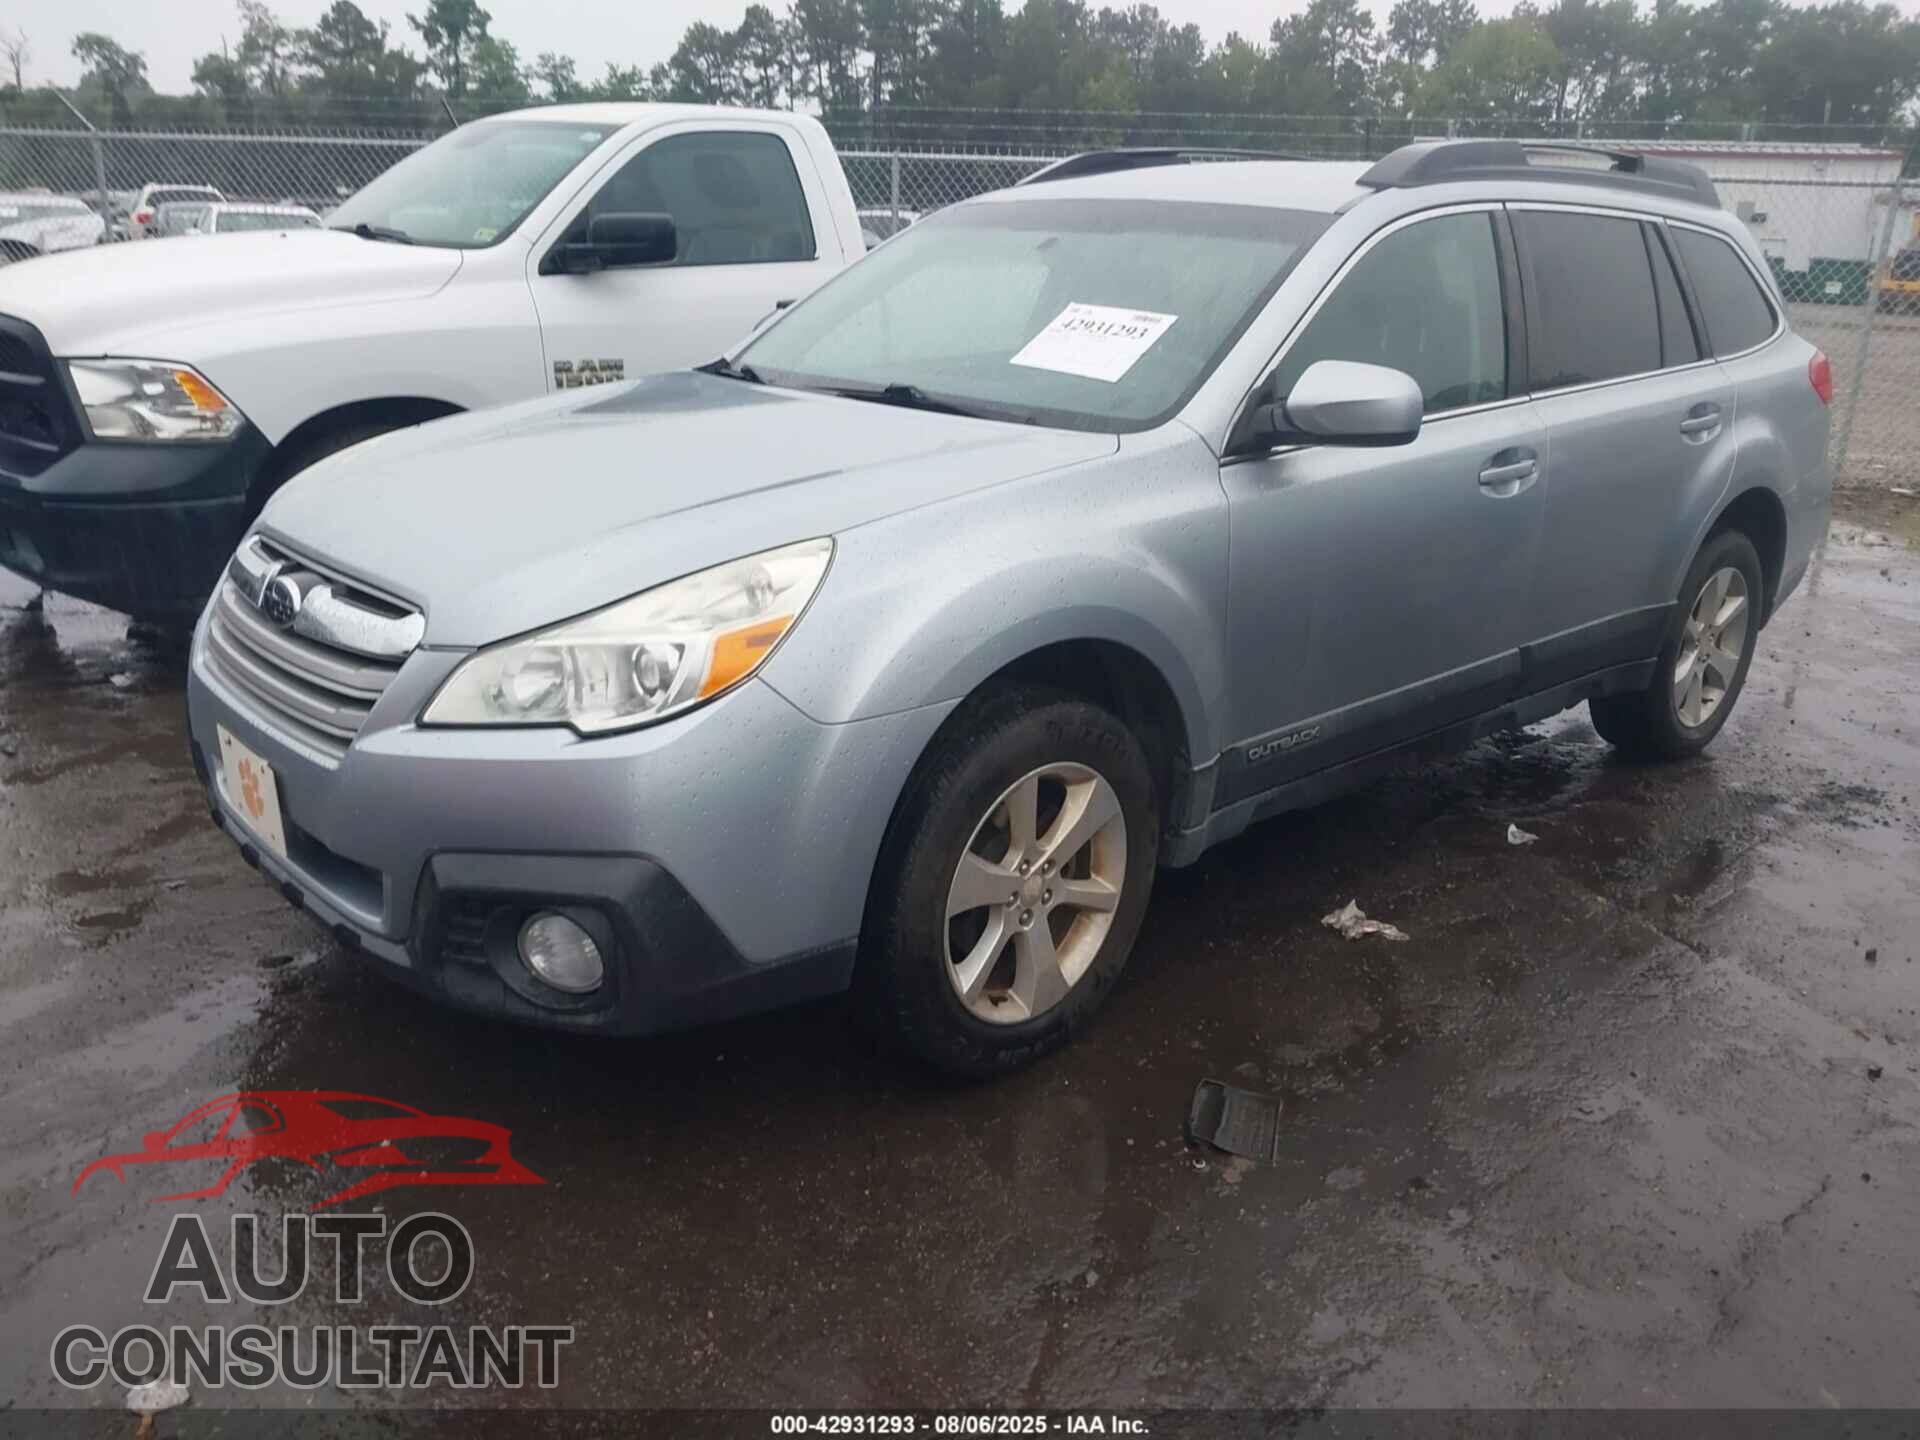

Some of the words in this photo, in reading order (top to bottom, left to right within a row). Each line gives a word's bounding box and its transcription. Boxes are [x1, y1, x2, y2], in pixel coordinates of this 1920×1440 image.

[1061, 318, 1149, 340] 42931293
[553, 359, 624, 373] RAM
[1248, 725, 1321, 760] OUTBACK
